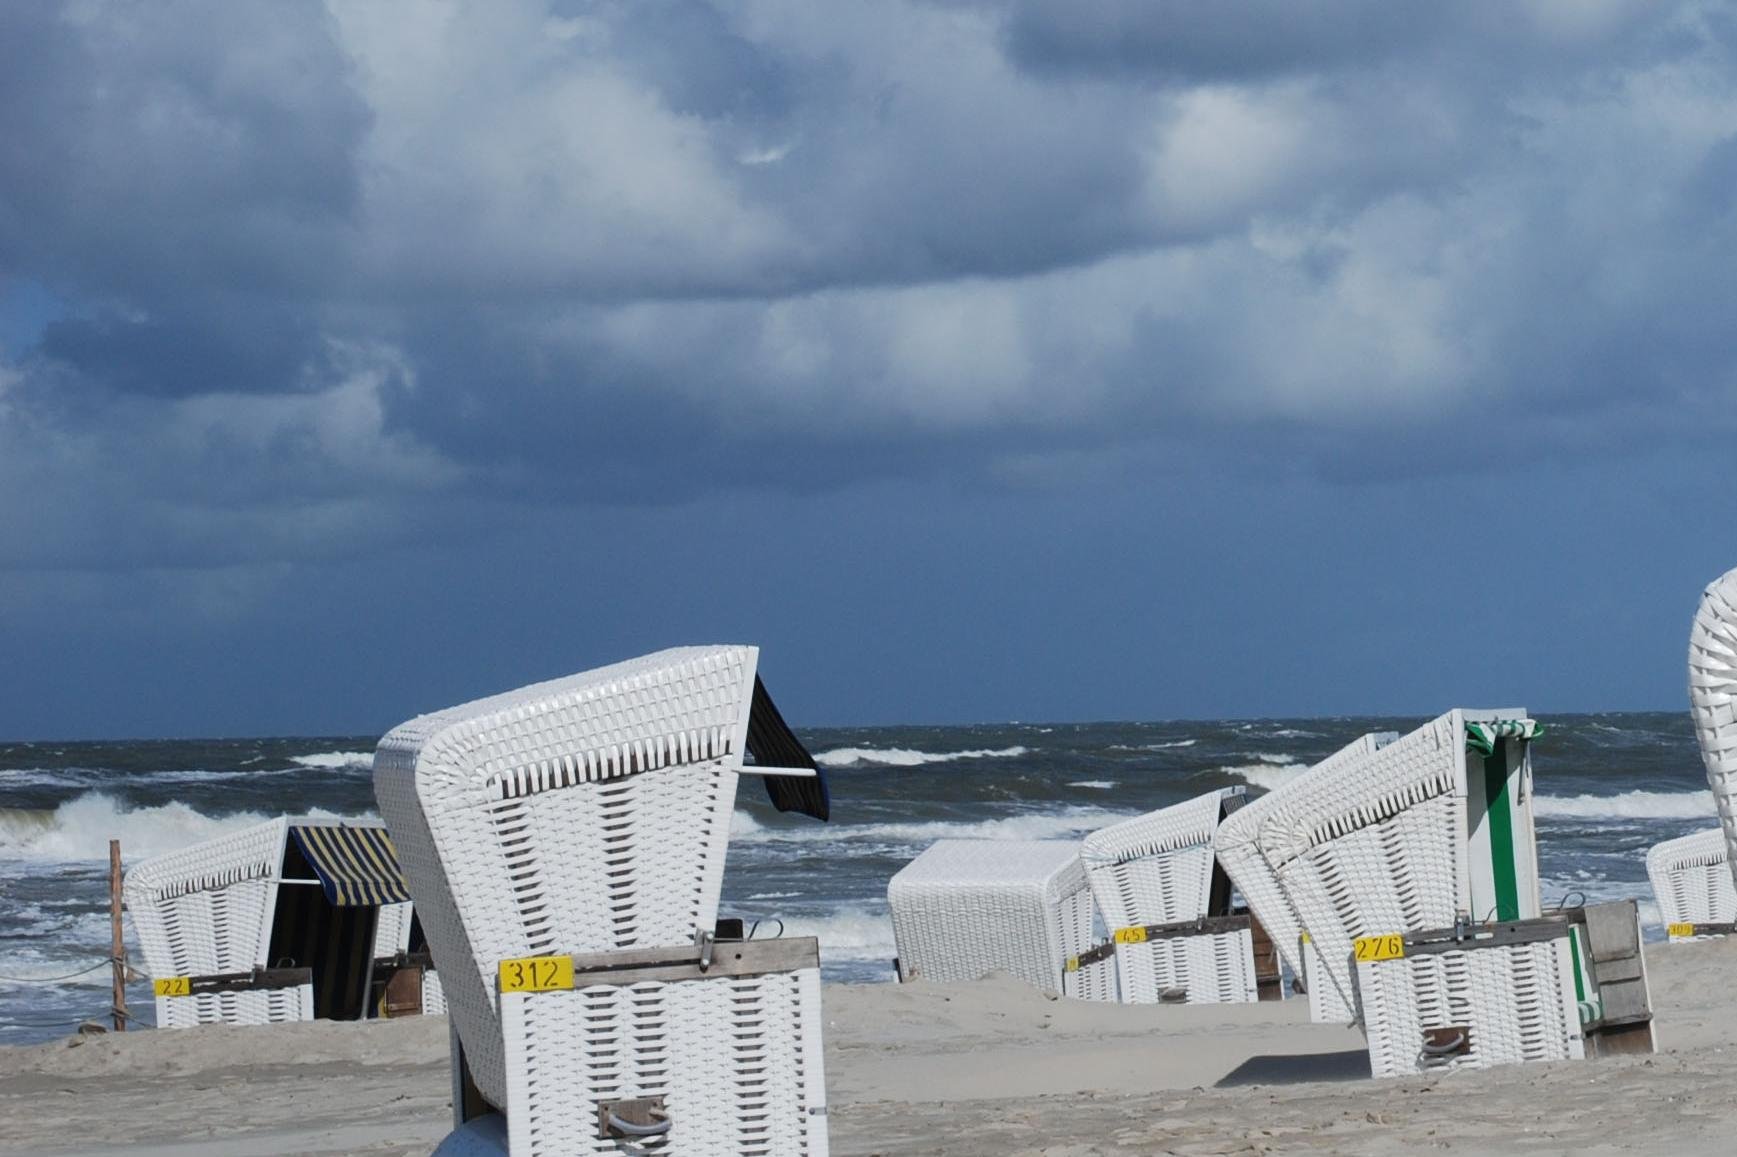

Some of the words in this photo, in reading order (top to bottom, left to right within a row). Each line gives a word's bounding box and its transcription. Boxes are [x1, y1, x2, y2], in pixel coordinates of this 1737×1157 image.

[1355, 937, 1400, 959] 276
[508, 961, 558, 988] 312
[163, 979, 183, 995] 22
